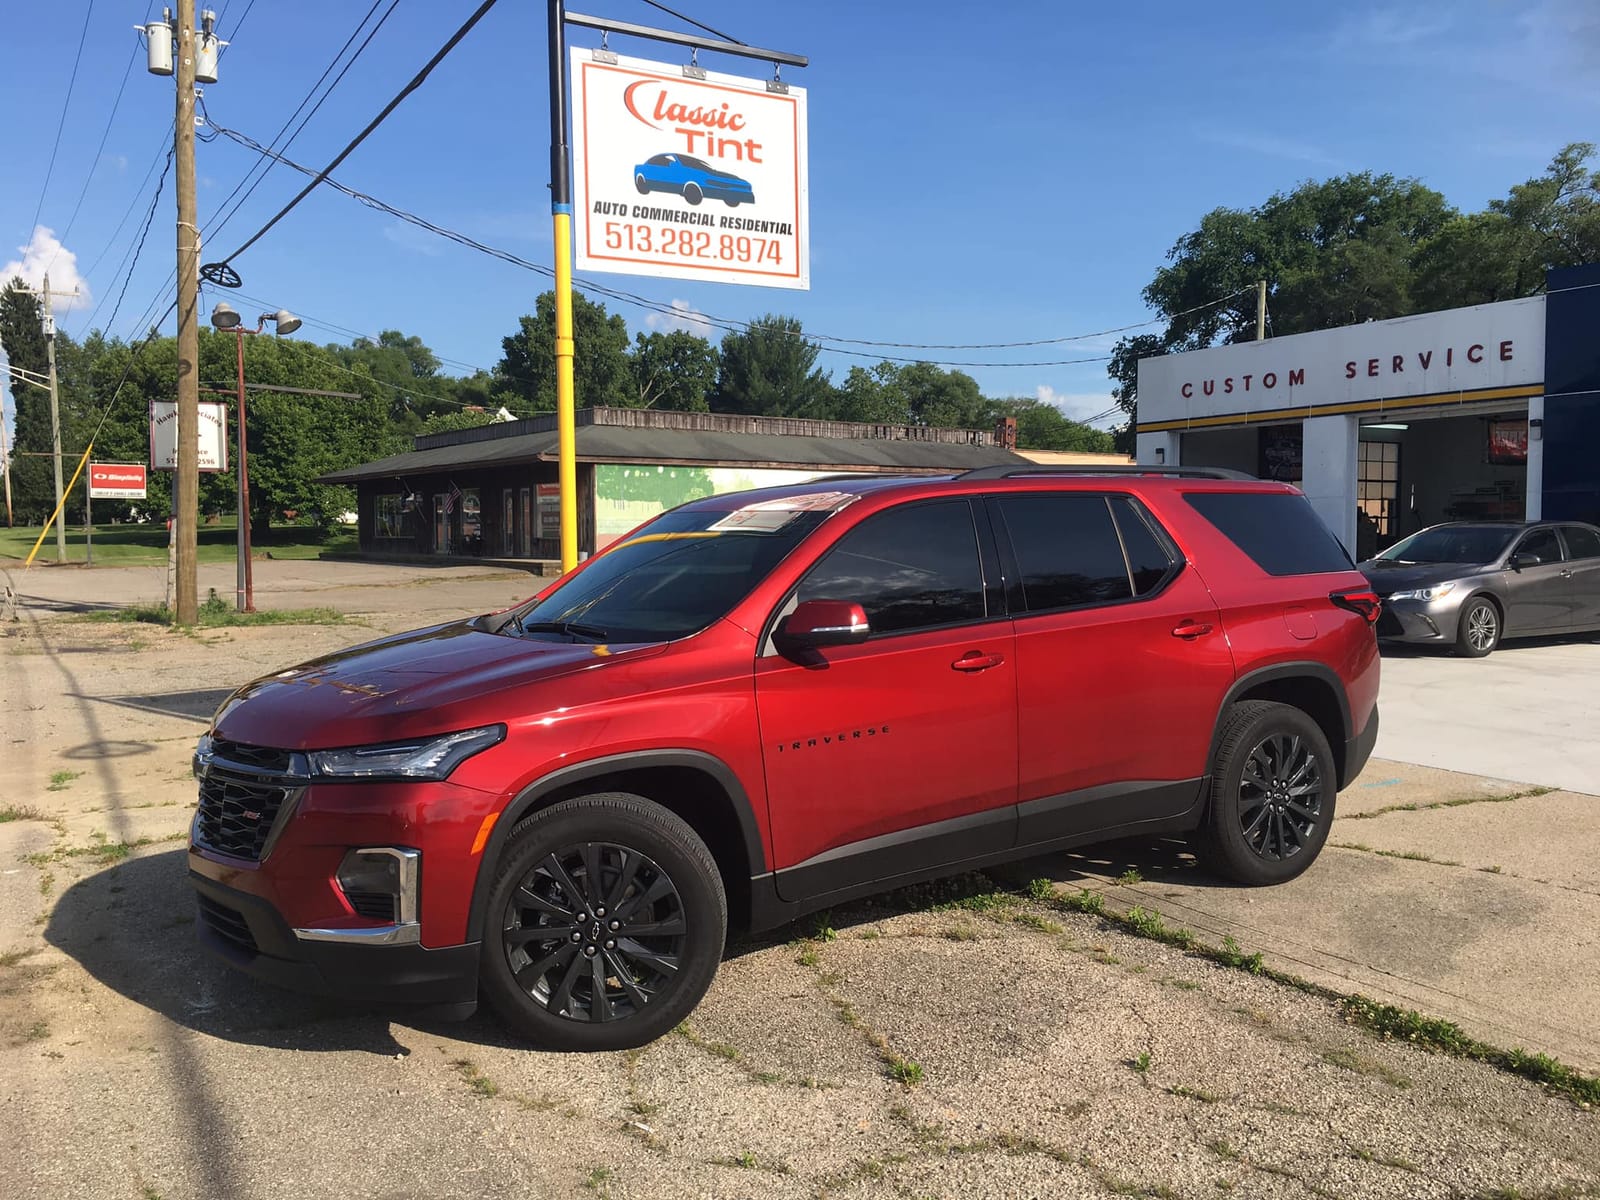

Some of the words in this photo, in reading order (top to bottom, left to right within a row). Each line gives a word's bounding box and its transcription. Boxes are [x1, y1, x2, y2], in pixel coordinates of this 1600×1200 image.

[623, 79, 746, 132] Classic
[675, 127, 763, 164] Tint
[593, 200, 628, 217] AUTO
[632, 205, 716, 227] COMMERCIAL
[719, 215, 793, 236] RESIDENTIAL
[605, 221, 783, 265] 513.282.8974
[1181, 368, 1306, 399] CUSTOM
[1345, 340, 1515, 379] SERVICE
[778, 726, 889, 753] TRAVERSE
